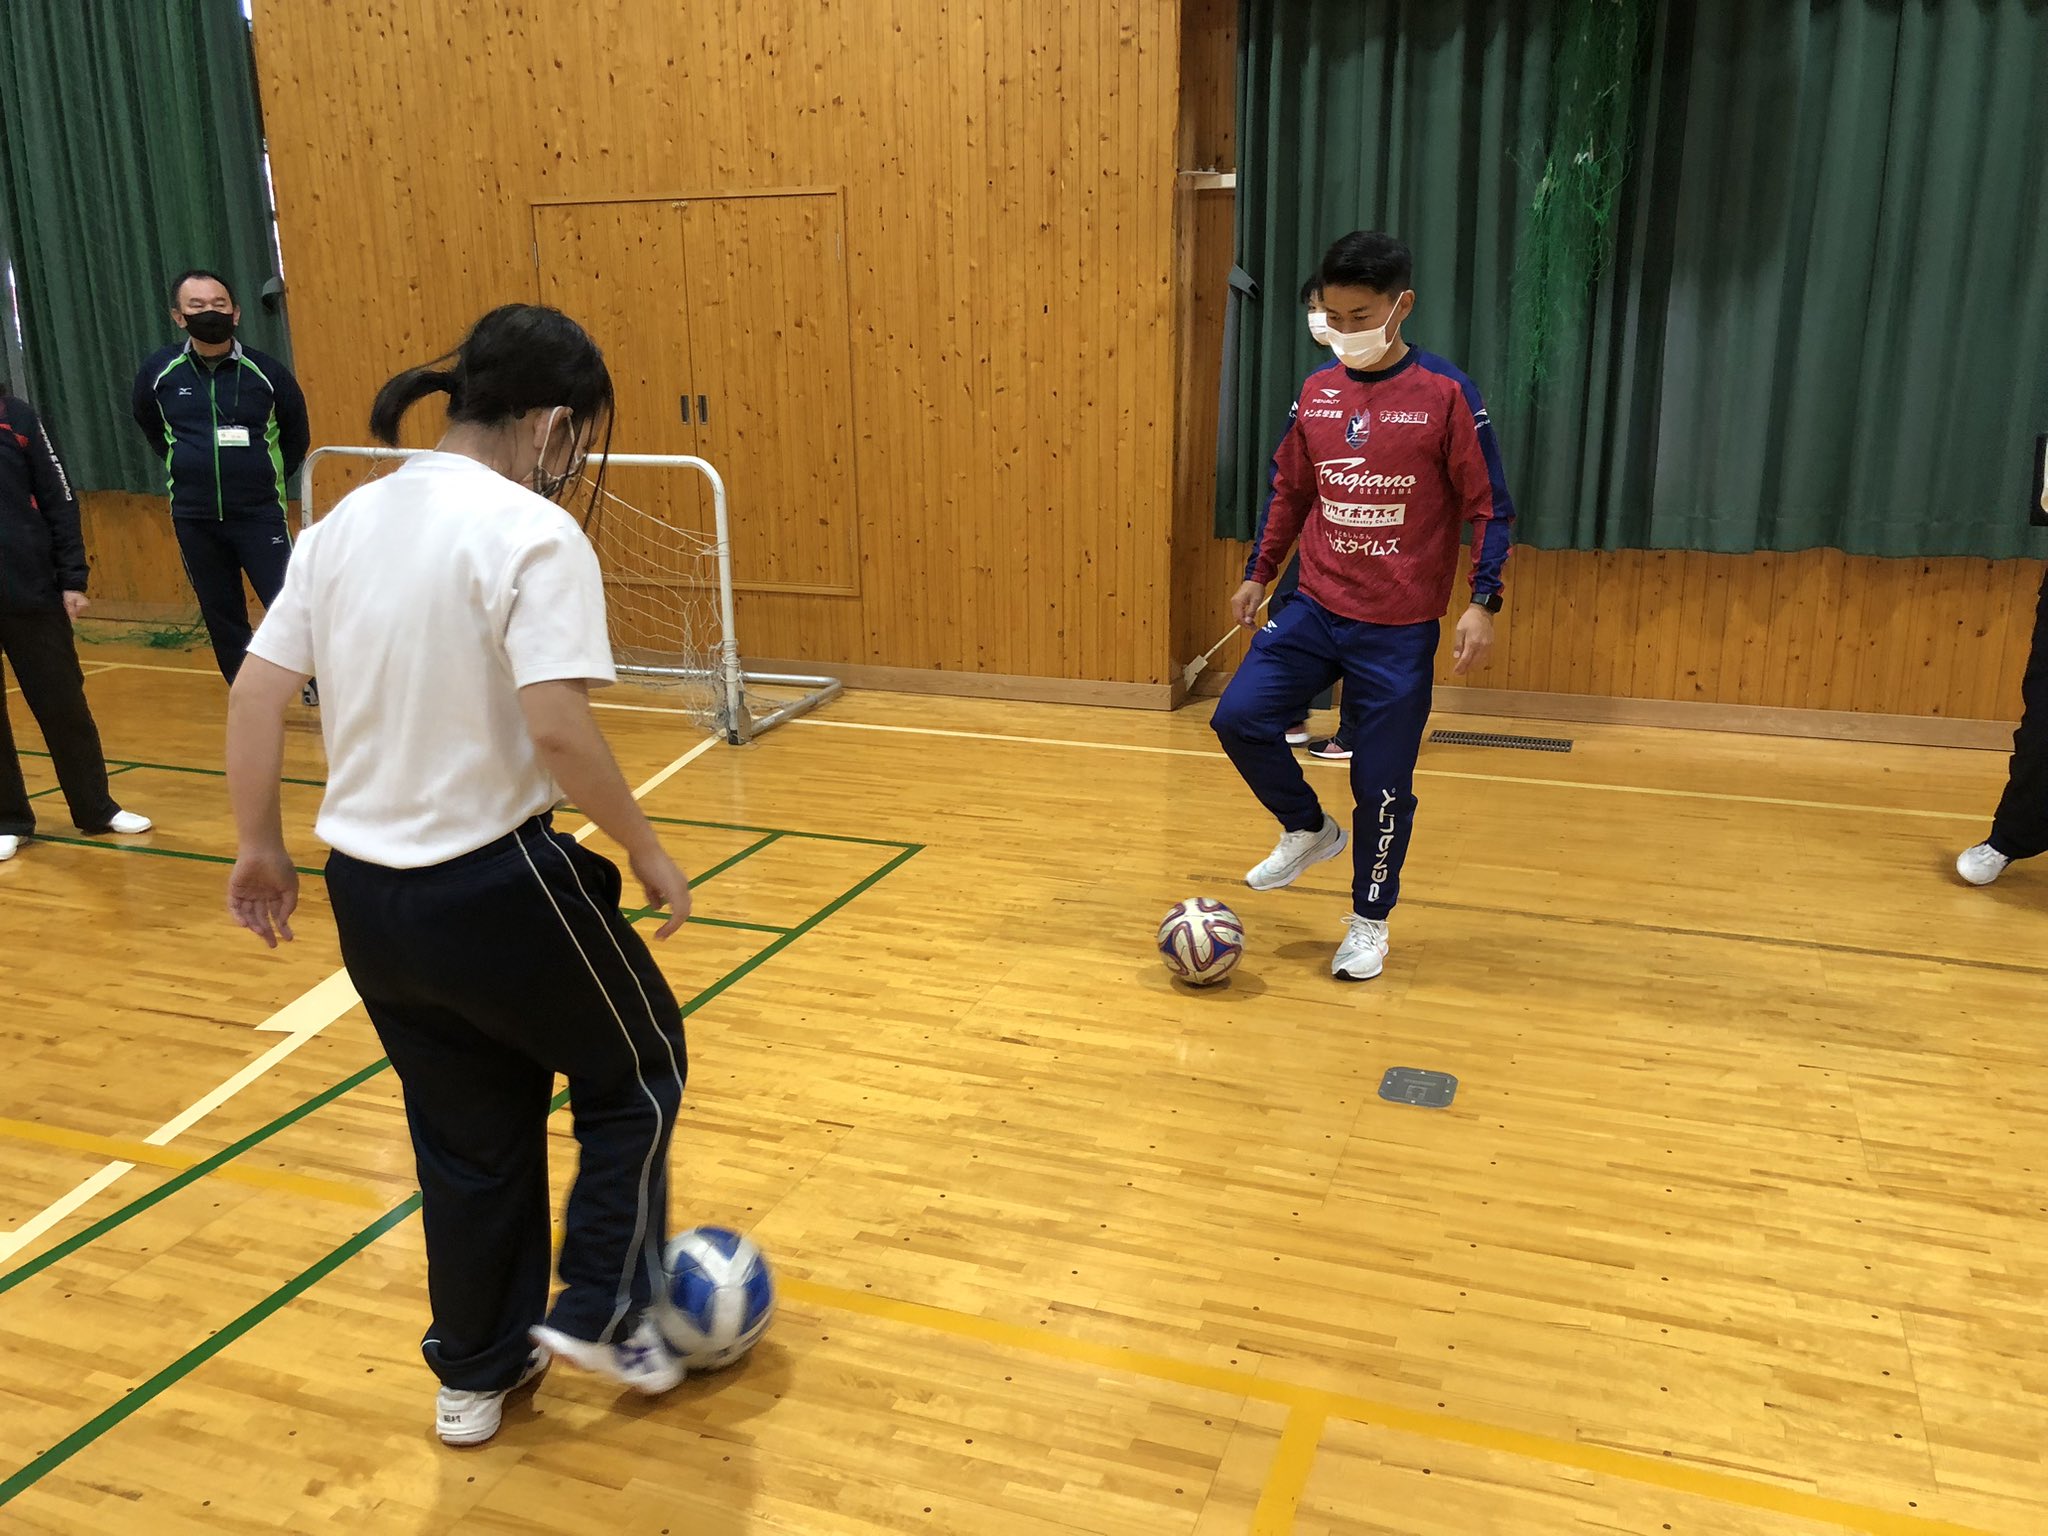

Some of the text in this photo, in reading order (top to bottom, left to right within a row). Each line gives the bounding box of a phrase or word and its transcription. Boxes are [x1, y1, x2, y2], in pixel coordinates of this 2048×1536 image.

[1380, 410, 1428, 424] おもちゃ王国
[1314, 457, 1417, 493] Fagiano
[1368, 789, 1396, 902] PENALTY
